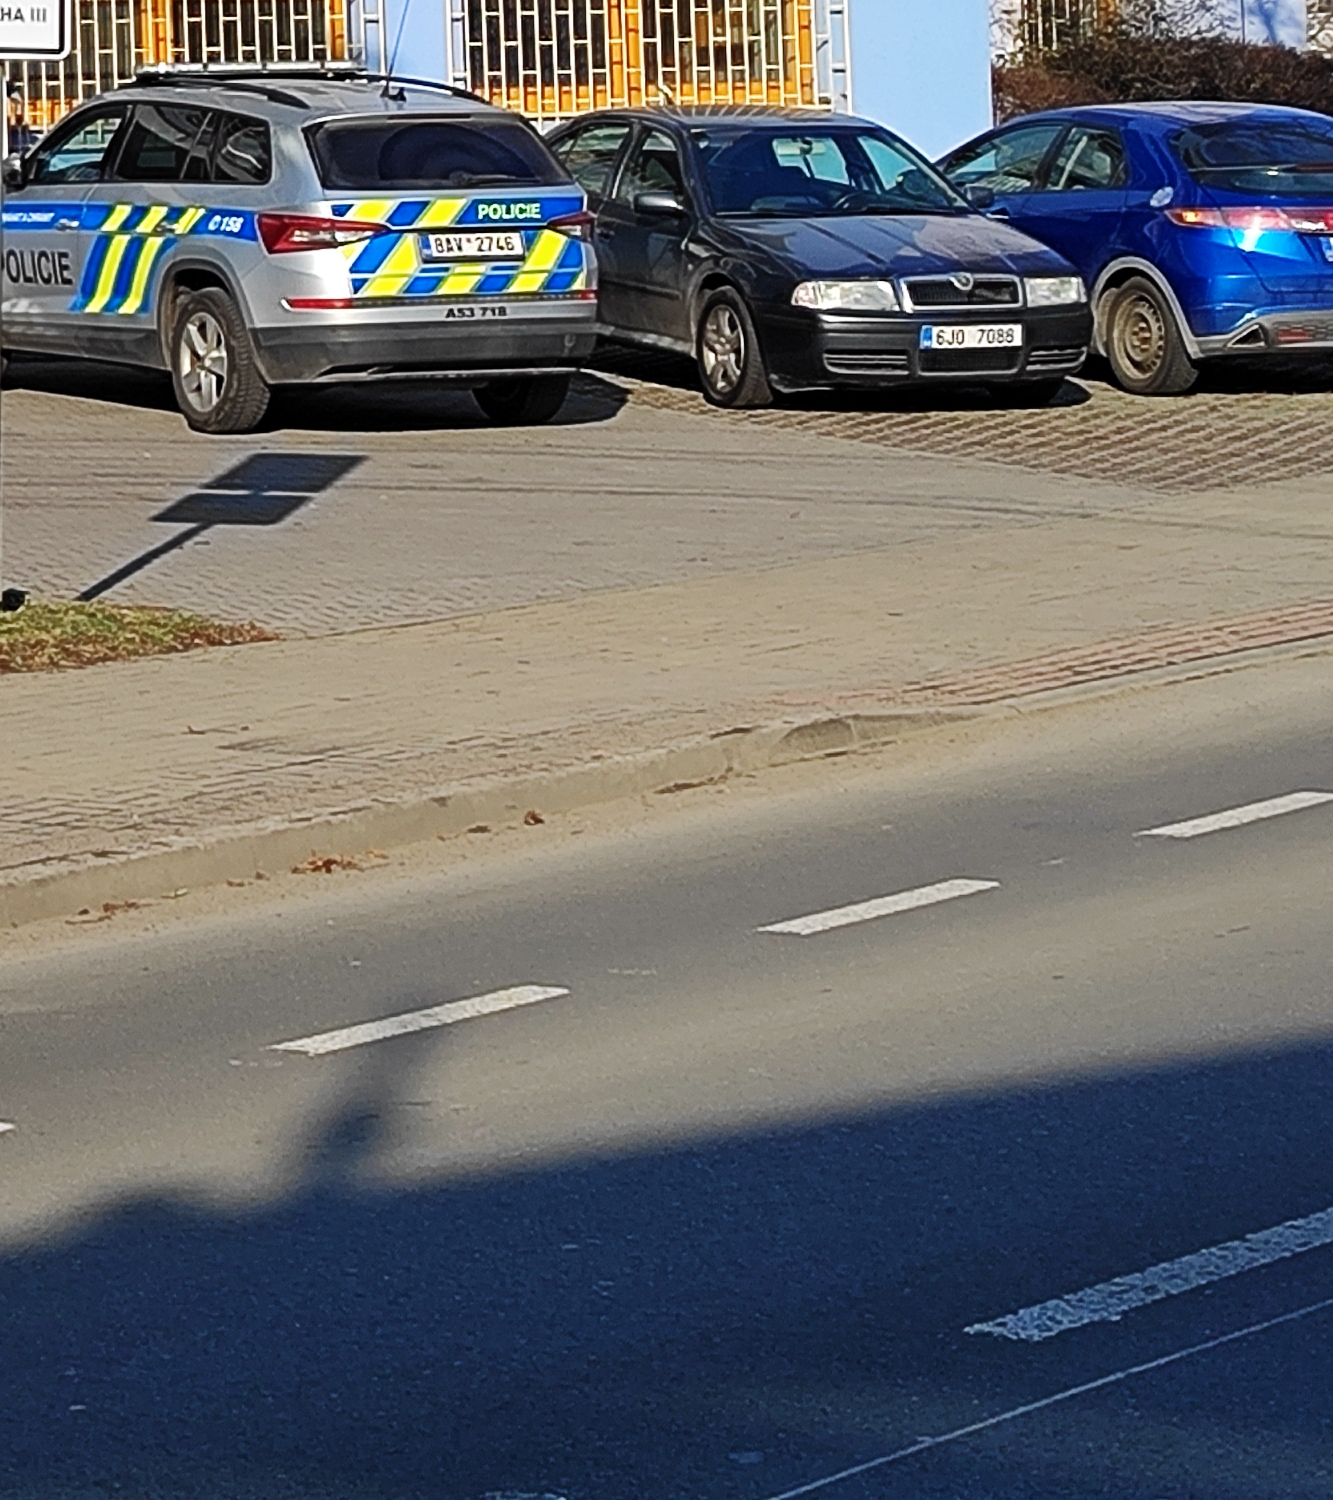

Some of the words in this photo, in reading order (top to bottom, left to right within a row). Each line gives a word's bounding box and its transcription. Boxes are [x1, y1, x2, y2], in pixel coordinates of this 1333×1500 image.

[31, 8, 47, 22] III
[478, 204, 541, 219] POLICIE
[220, 216, 244, 232] 158
[476, 236, 515, 252] 2746
[1, 250, 73, 285] OLICIE
[977, 328, 1014, 344] 7088
